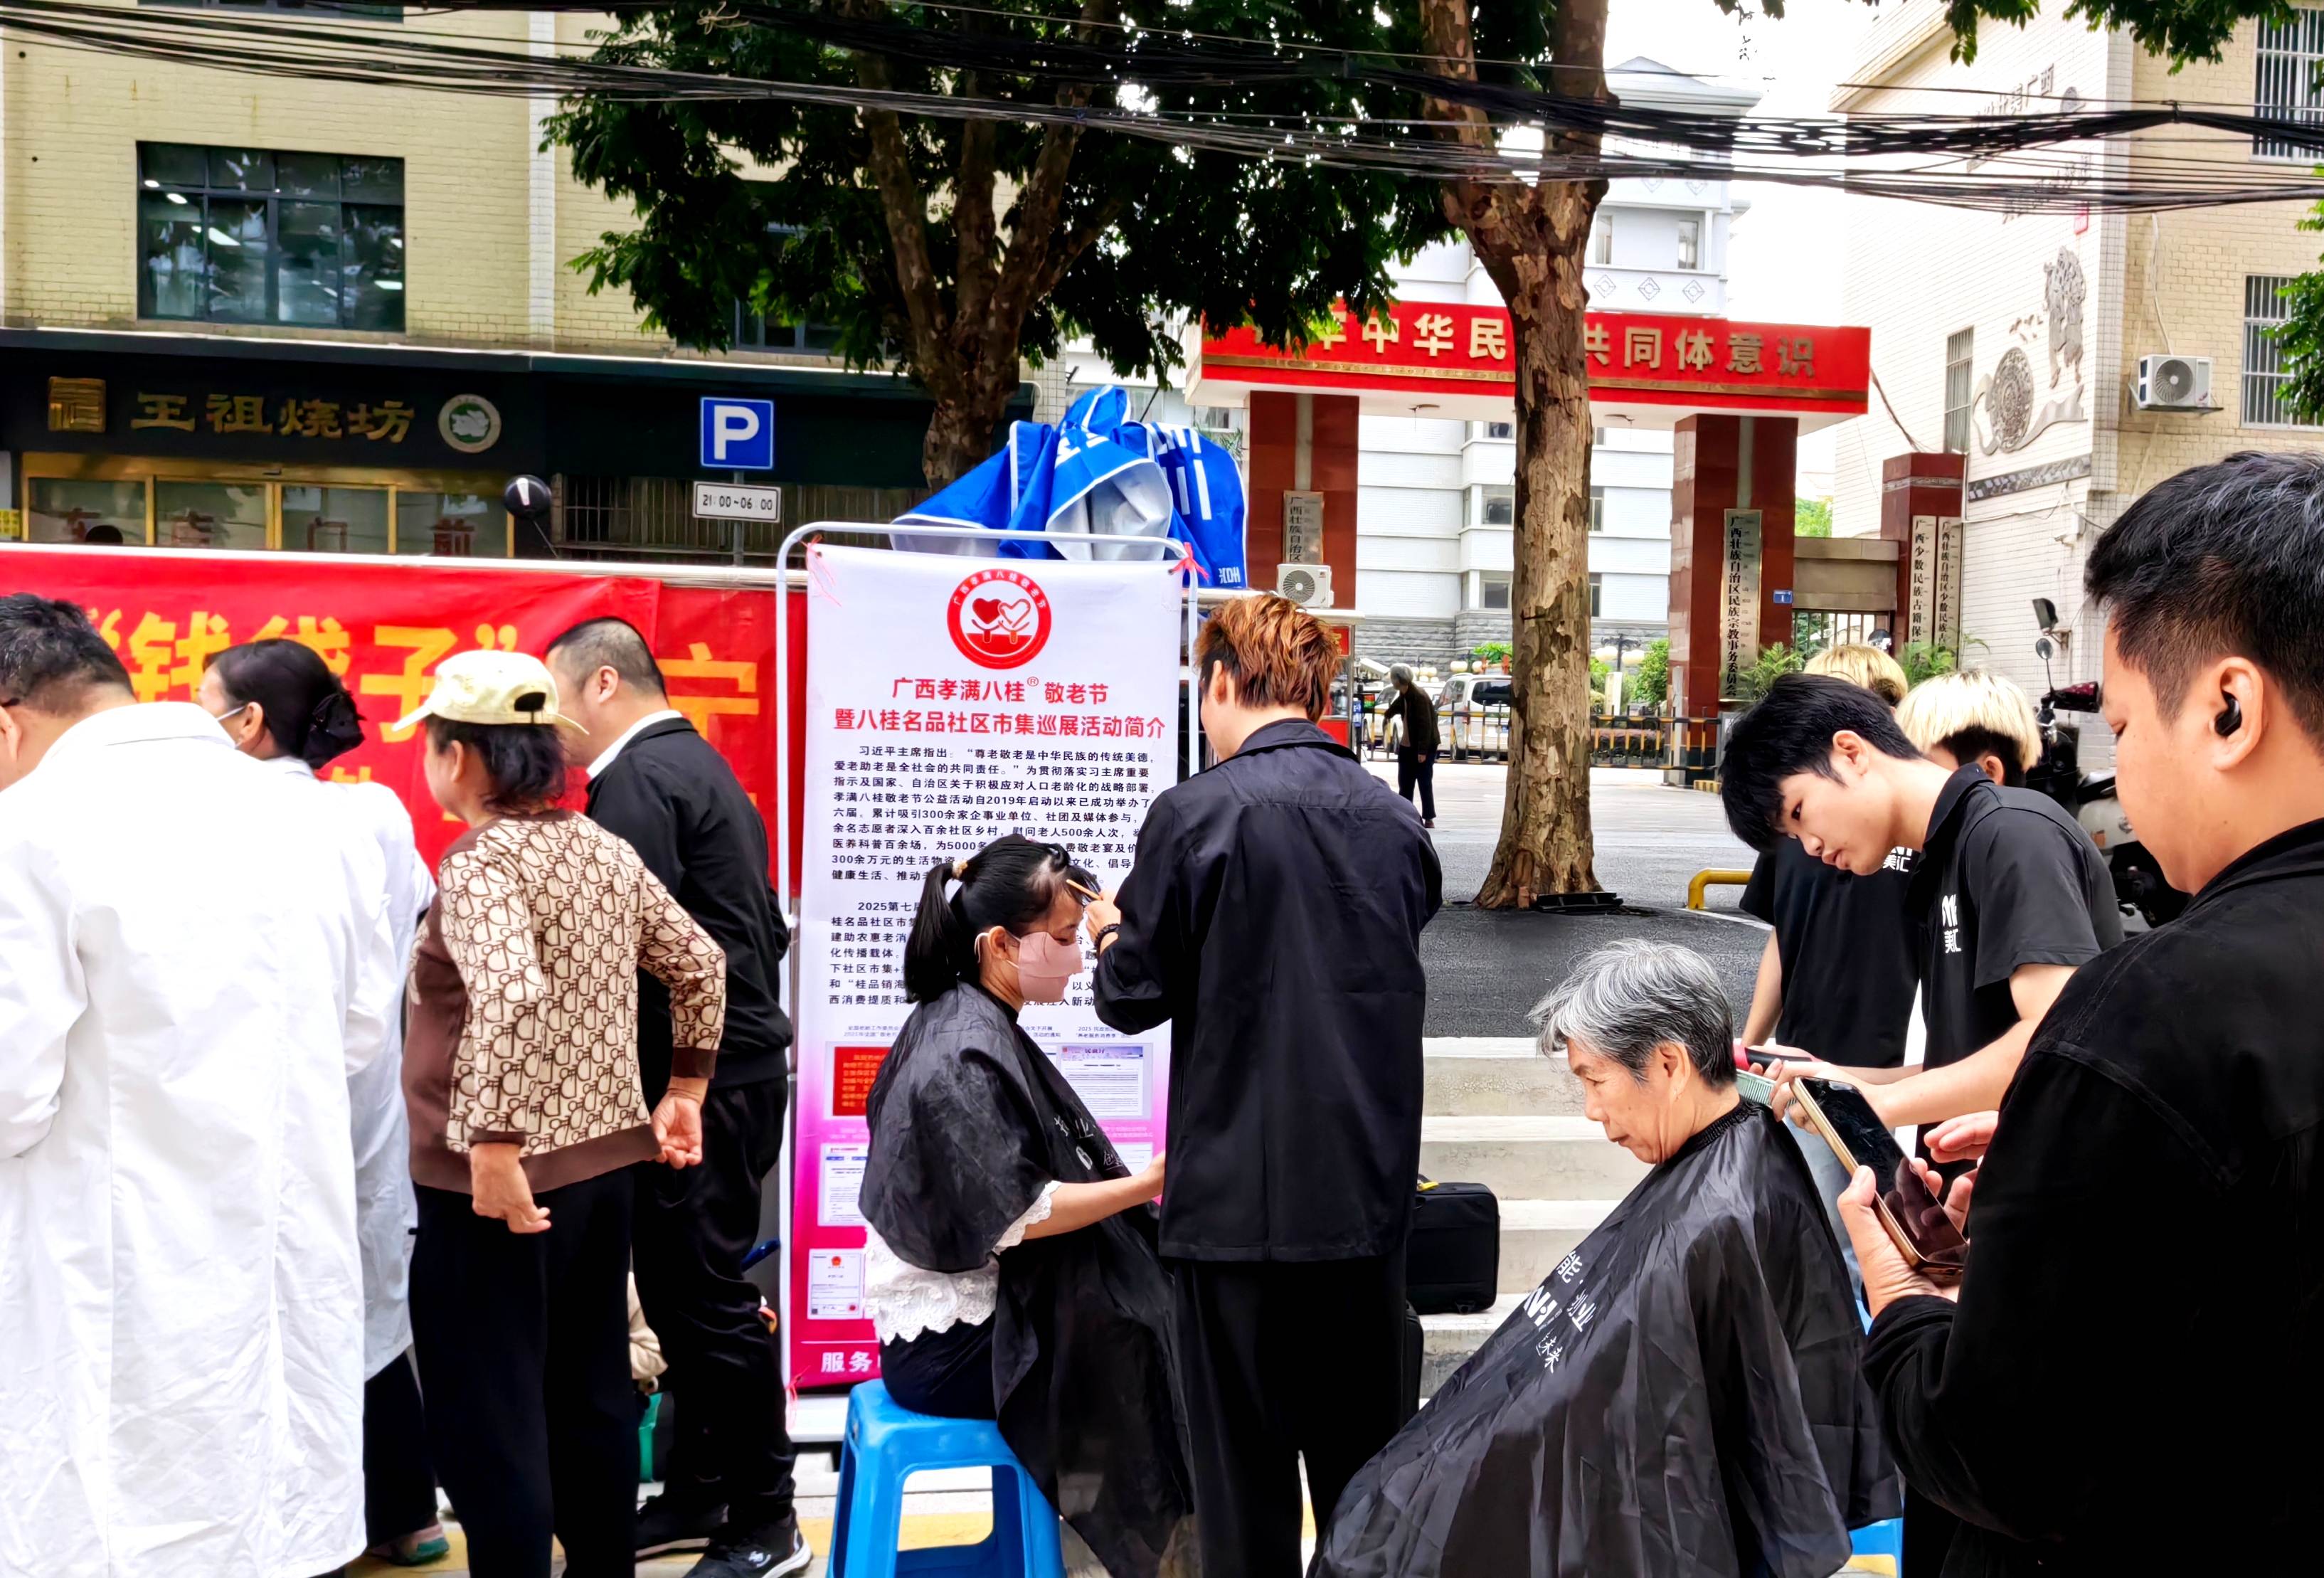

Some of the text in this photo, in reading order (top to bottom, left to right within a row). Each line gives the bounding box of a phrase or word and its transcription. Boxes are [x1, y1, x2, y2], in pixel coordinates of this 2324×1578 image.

[131, 392, 415, 443] 王祖烧坊
[714, 405, 760, 460] P
[1911, 519, 1926, 643] 广西少数民族古籍保
[1725, 515, 1743, 697] 广西壮族自治区民族宗教事务委员会
[834, 709, 1165, 739] 暨八桂名品社区市集巡展活动简介
[833, 791, 1150, 809] 孝满八桂敬老节公益活动自2019年启动以来已成功举办了
[1071, 858, 1134, 869] 文化、倡导
[821, 1351, 881, 1372] 服务
